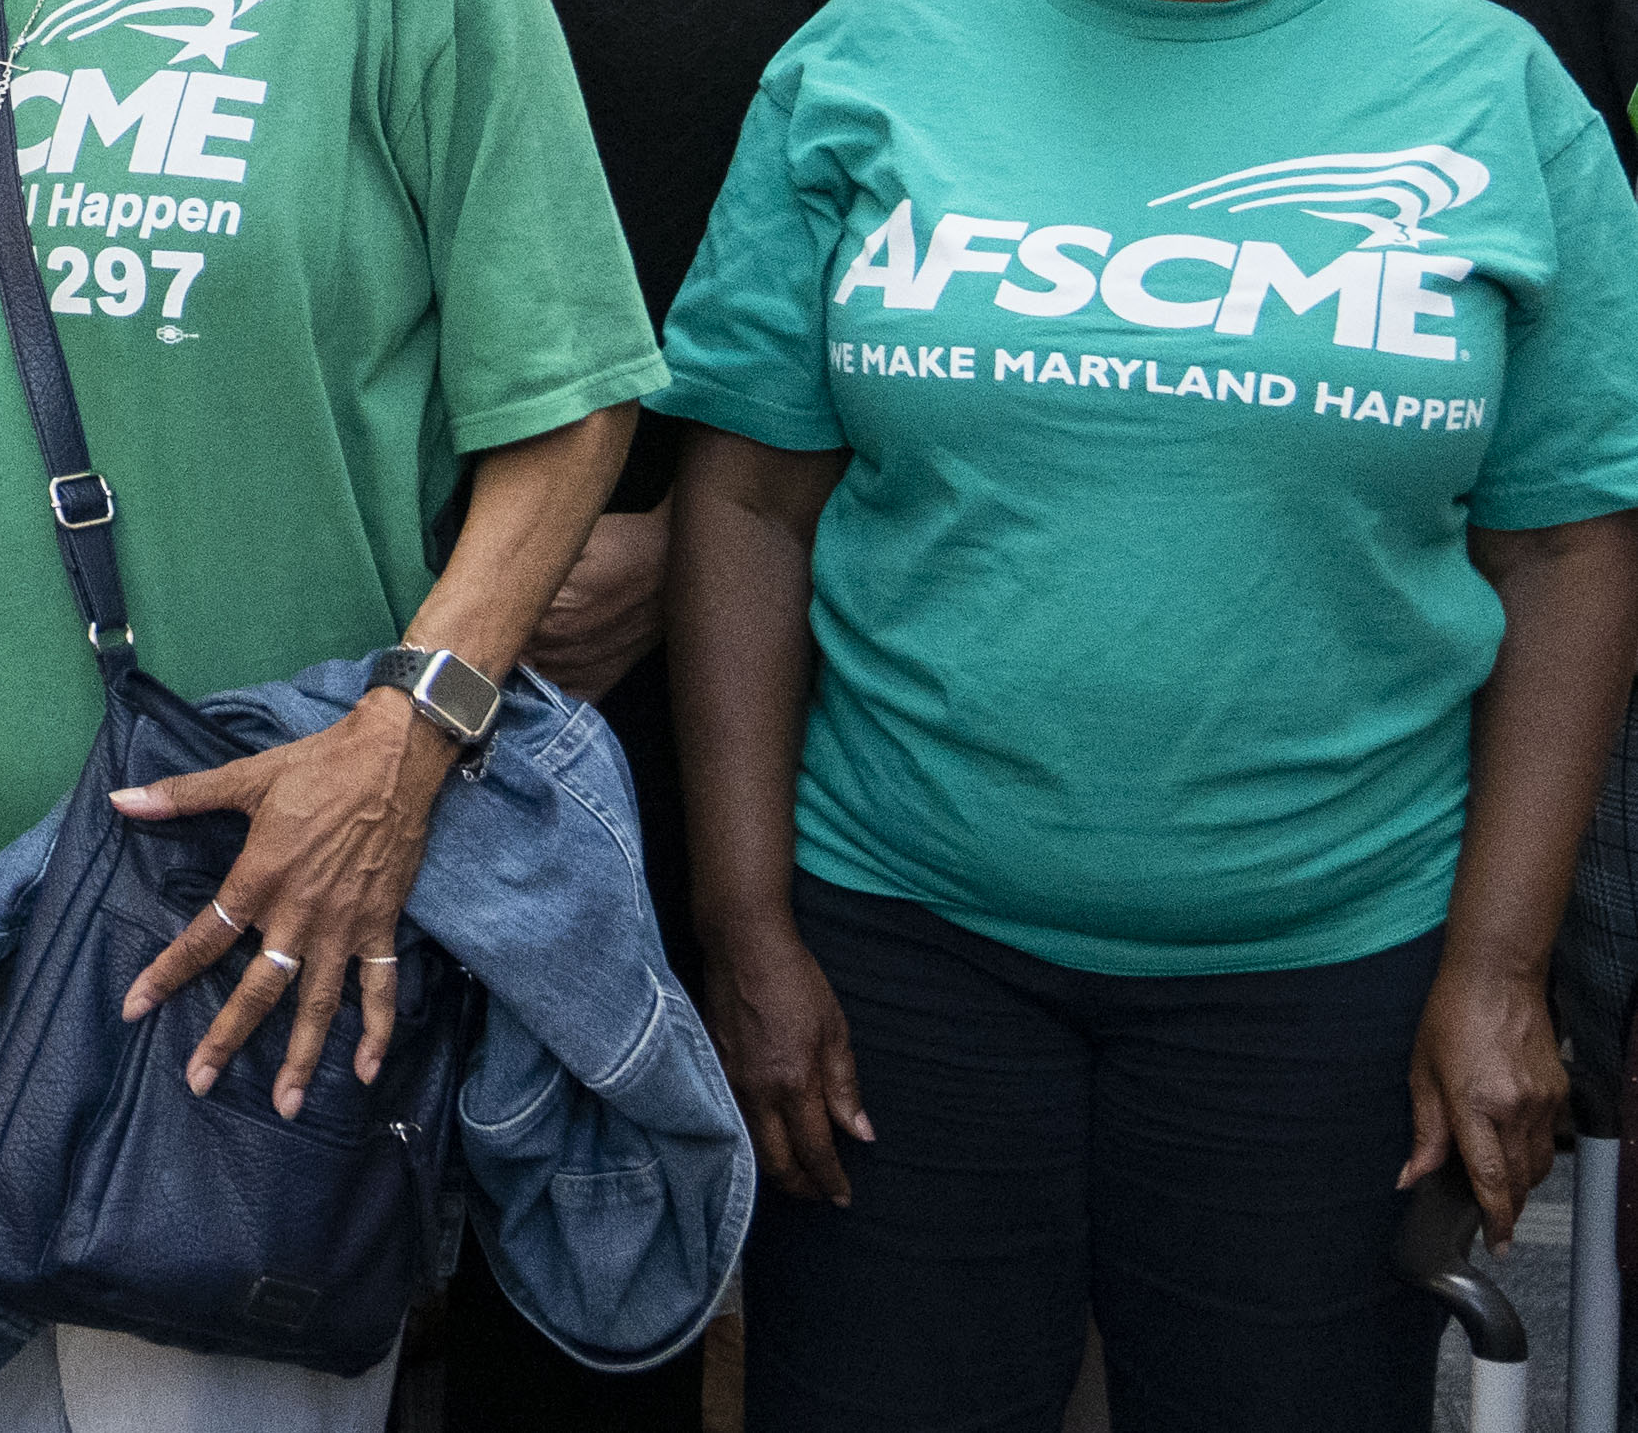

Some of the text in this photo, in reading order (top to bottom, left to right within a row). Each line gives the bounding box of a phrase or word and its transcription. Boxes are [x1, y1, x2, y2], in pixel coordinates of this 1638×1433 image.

[47, 182, 242, 238] Happen
[32, 245, 205, 319] 297
[833, 198, 1474, 361] AFSCME
[862, 343, 976, 379] MAKE
[994, 348, 1297, 409] MARYLAND
[1314, 381, 1486, 431] HAPPEN
